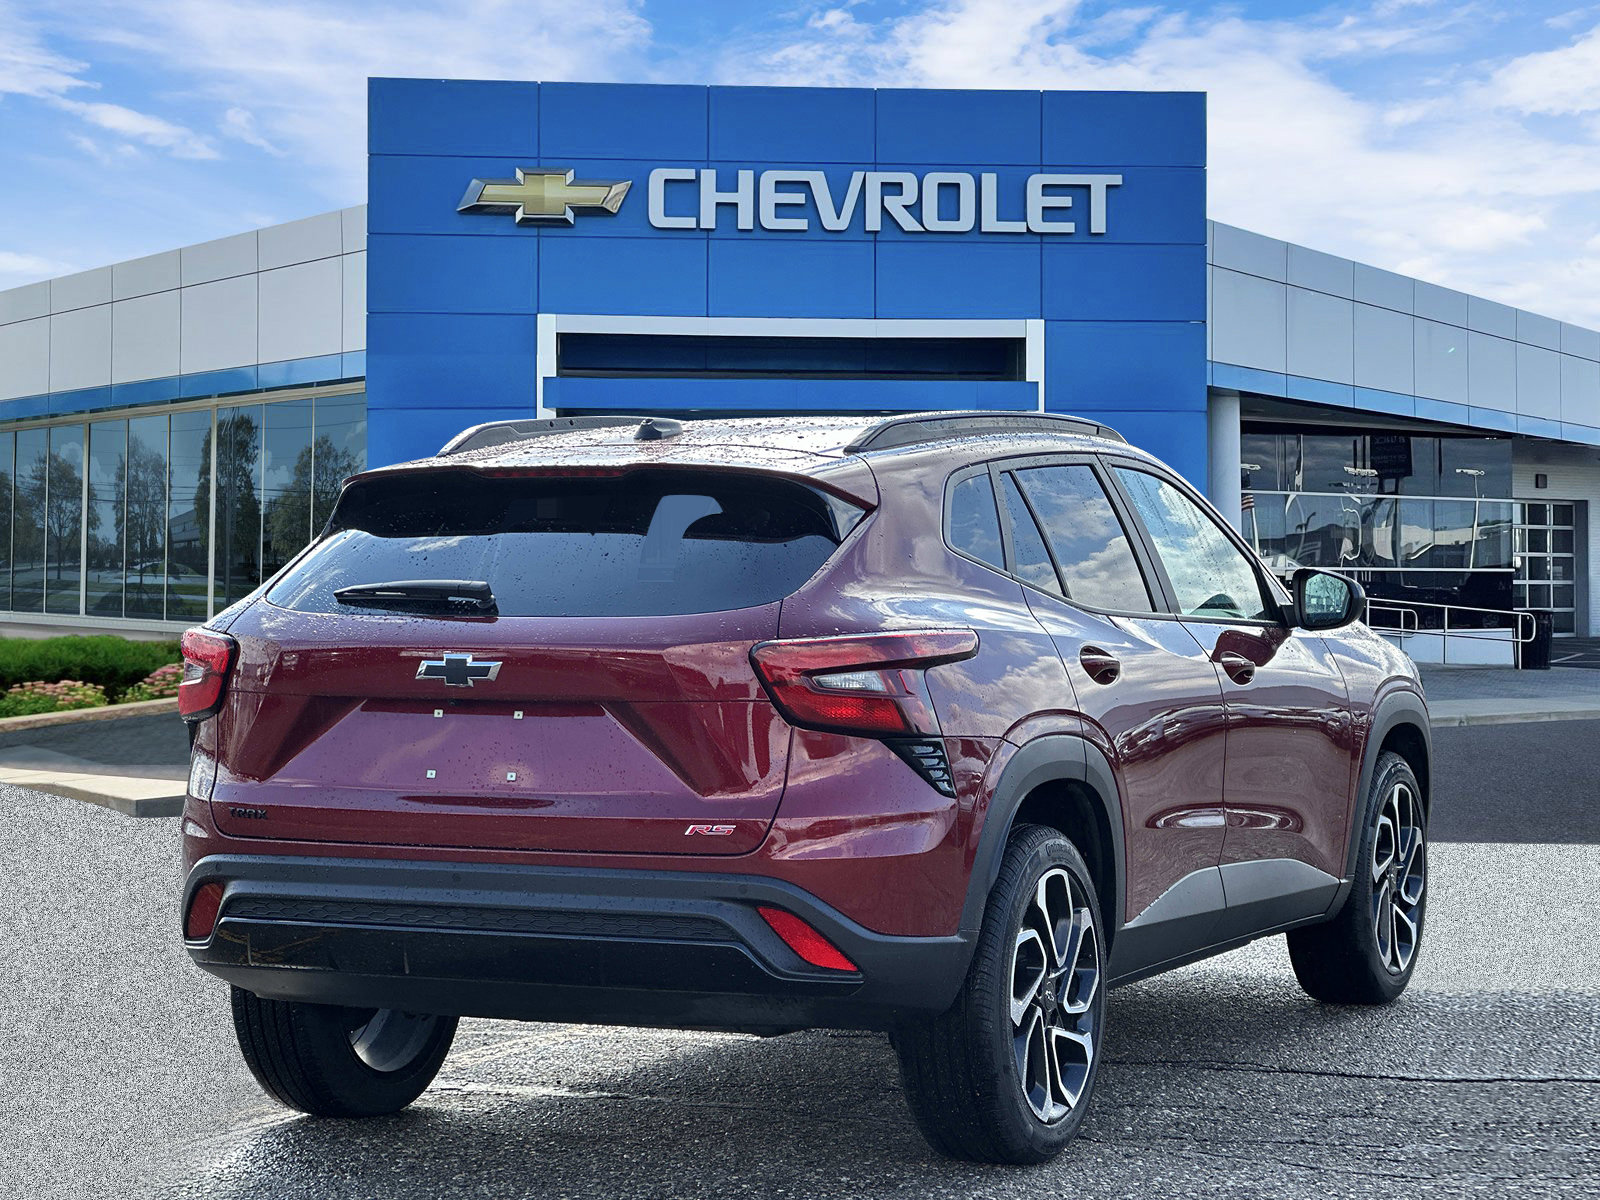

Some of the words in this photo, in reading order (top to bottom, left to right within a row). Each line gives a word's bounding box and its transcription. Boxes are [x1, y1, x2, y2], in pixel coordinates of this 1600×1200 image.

[648, 168, 1123, 234] CHEVROLET
[228, 806, 268, 820] TRAX
[684, 824, 737, 836] RS
